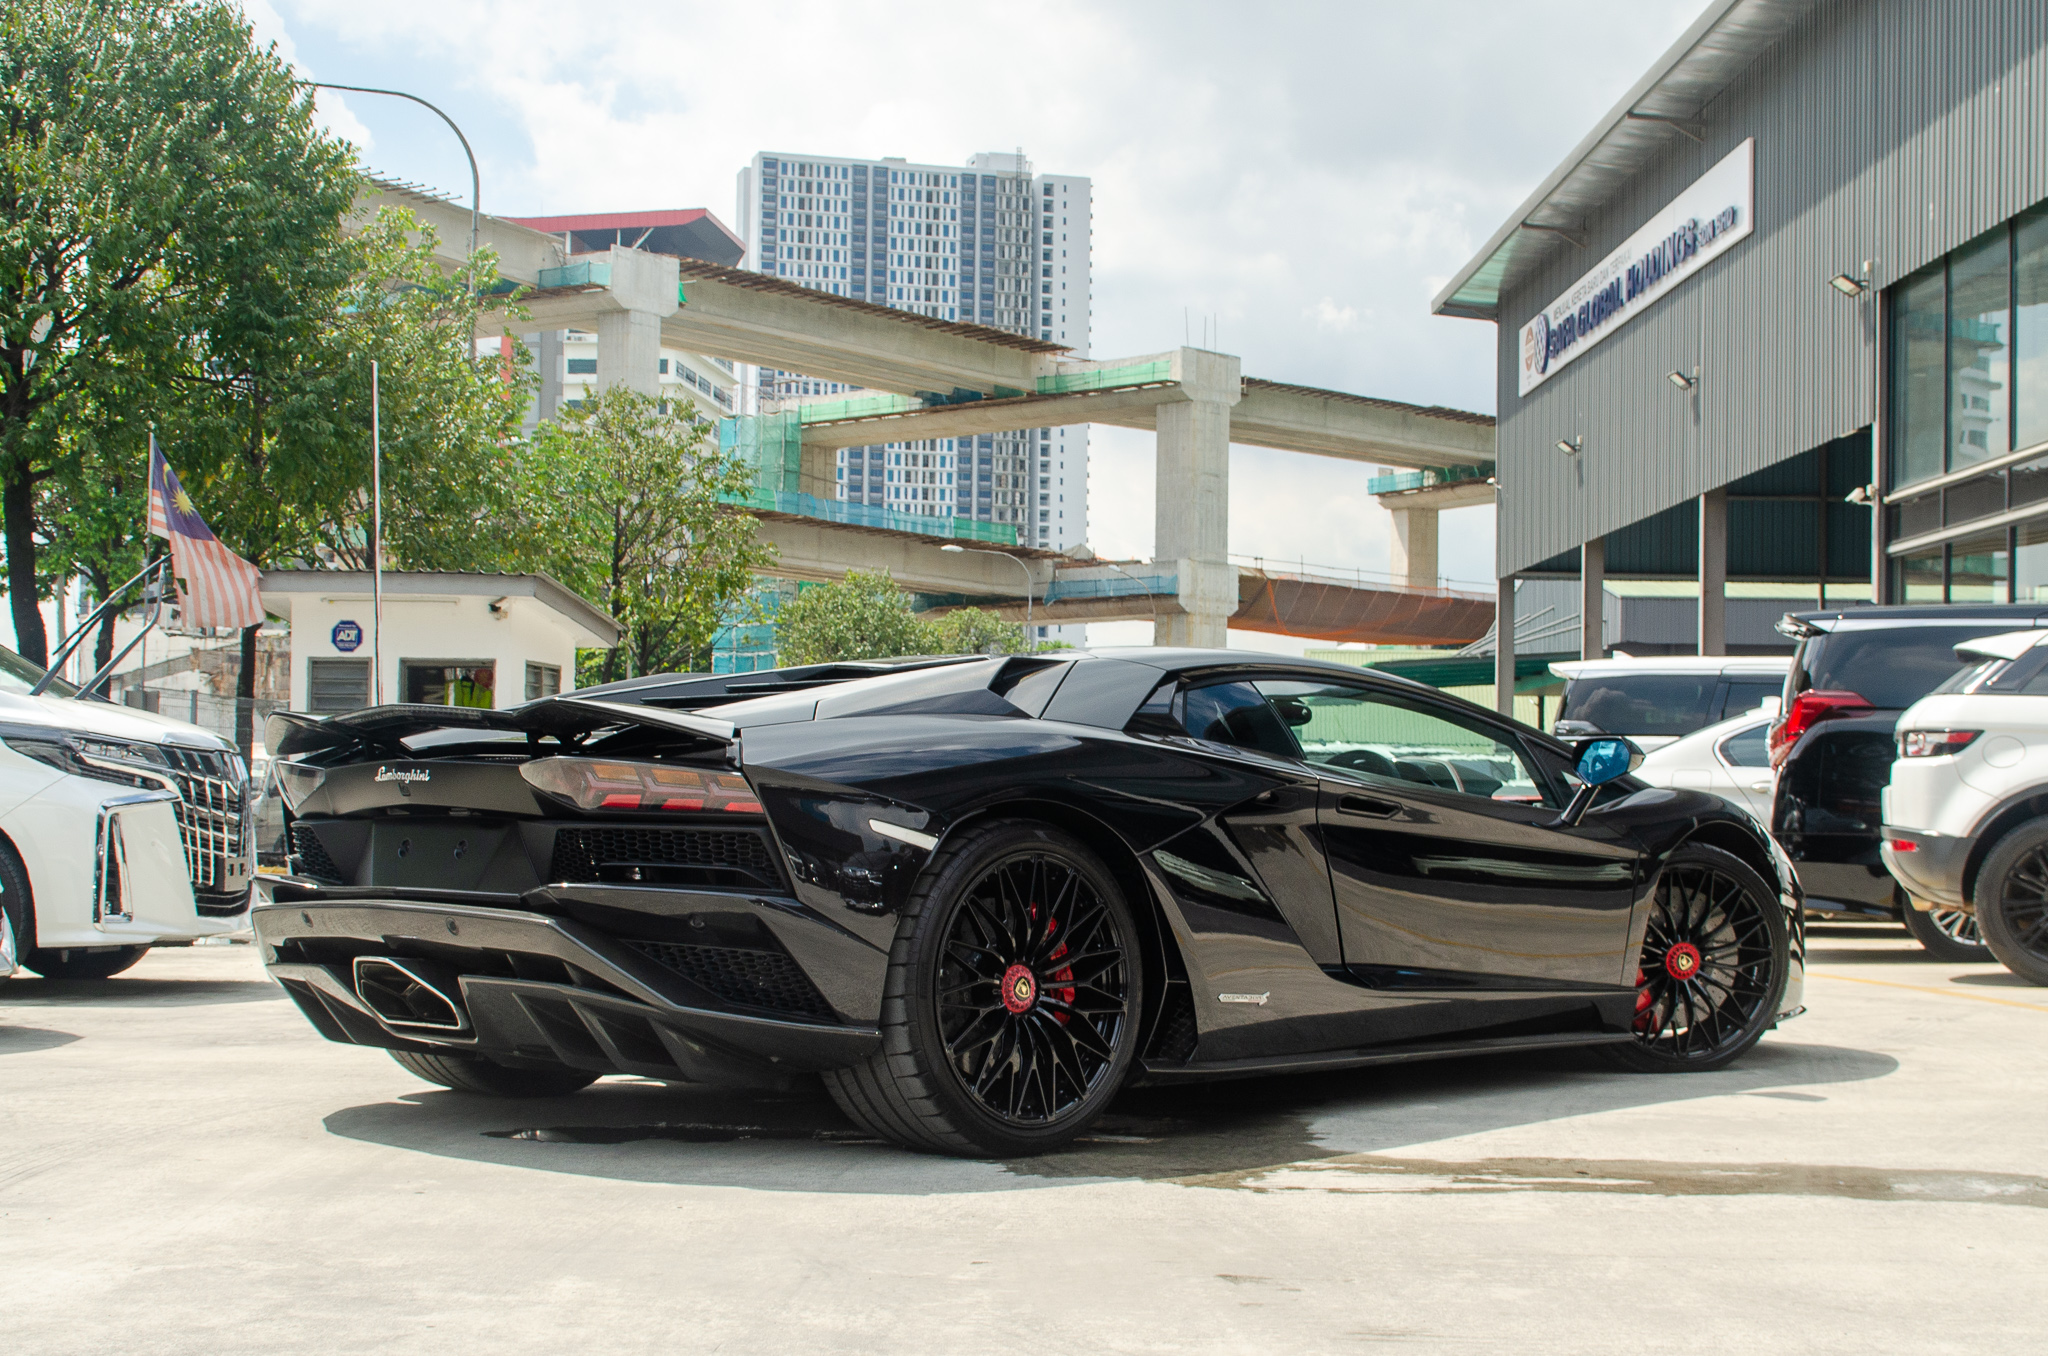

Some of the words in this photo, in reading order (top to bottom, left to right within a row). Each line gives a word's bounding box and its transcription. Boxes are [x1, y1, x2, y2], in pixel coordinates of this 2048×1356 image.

[1549, 313, 1577, 359] SAFA
[1577, 277, 1624, 337] GLOBAL
[1626, 218, 1698, 302] HOLDINGS
[1697, 219, 1715, 247] SDN
[337, 630, 357, 642] ADT
[374, 766, 431, 784] Lamborghini
